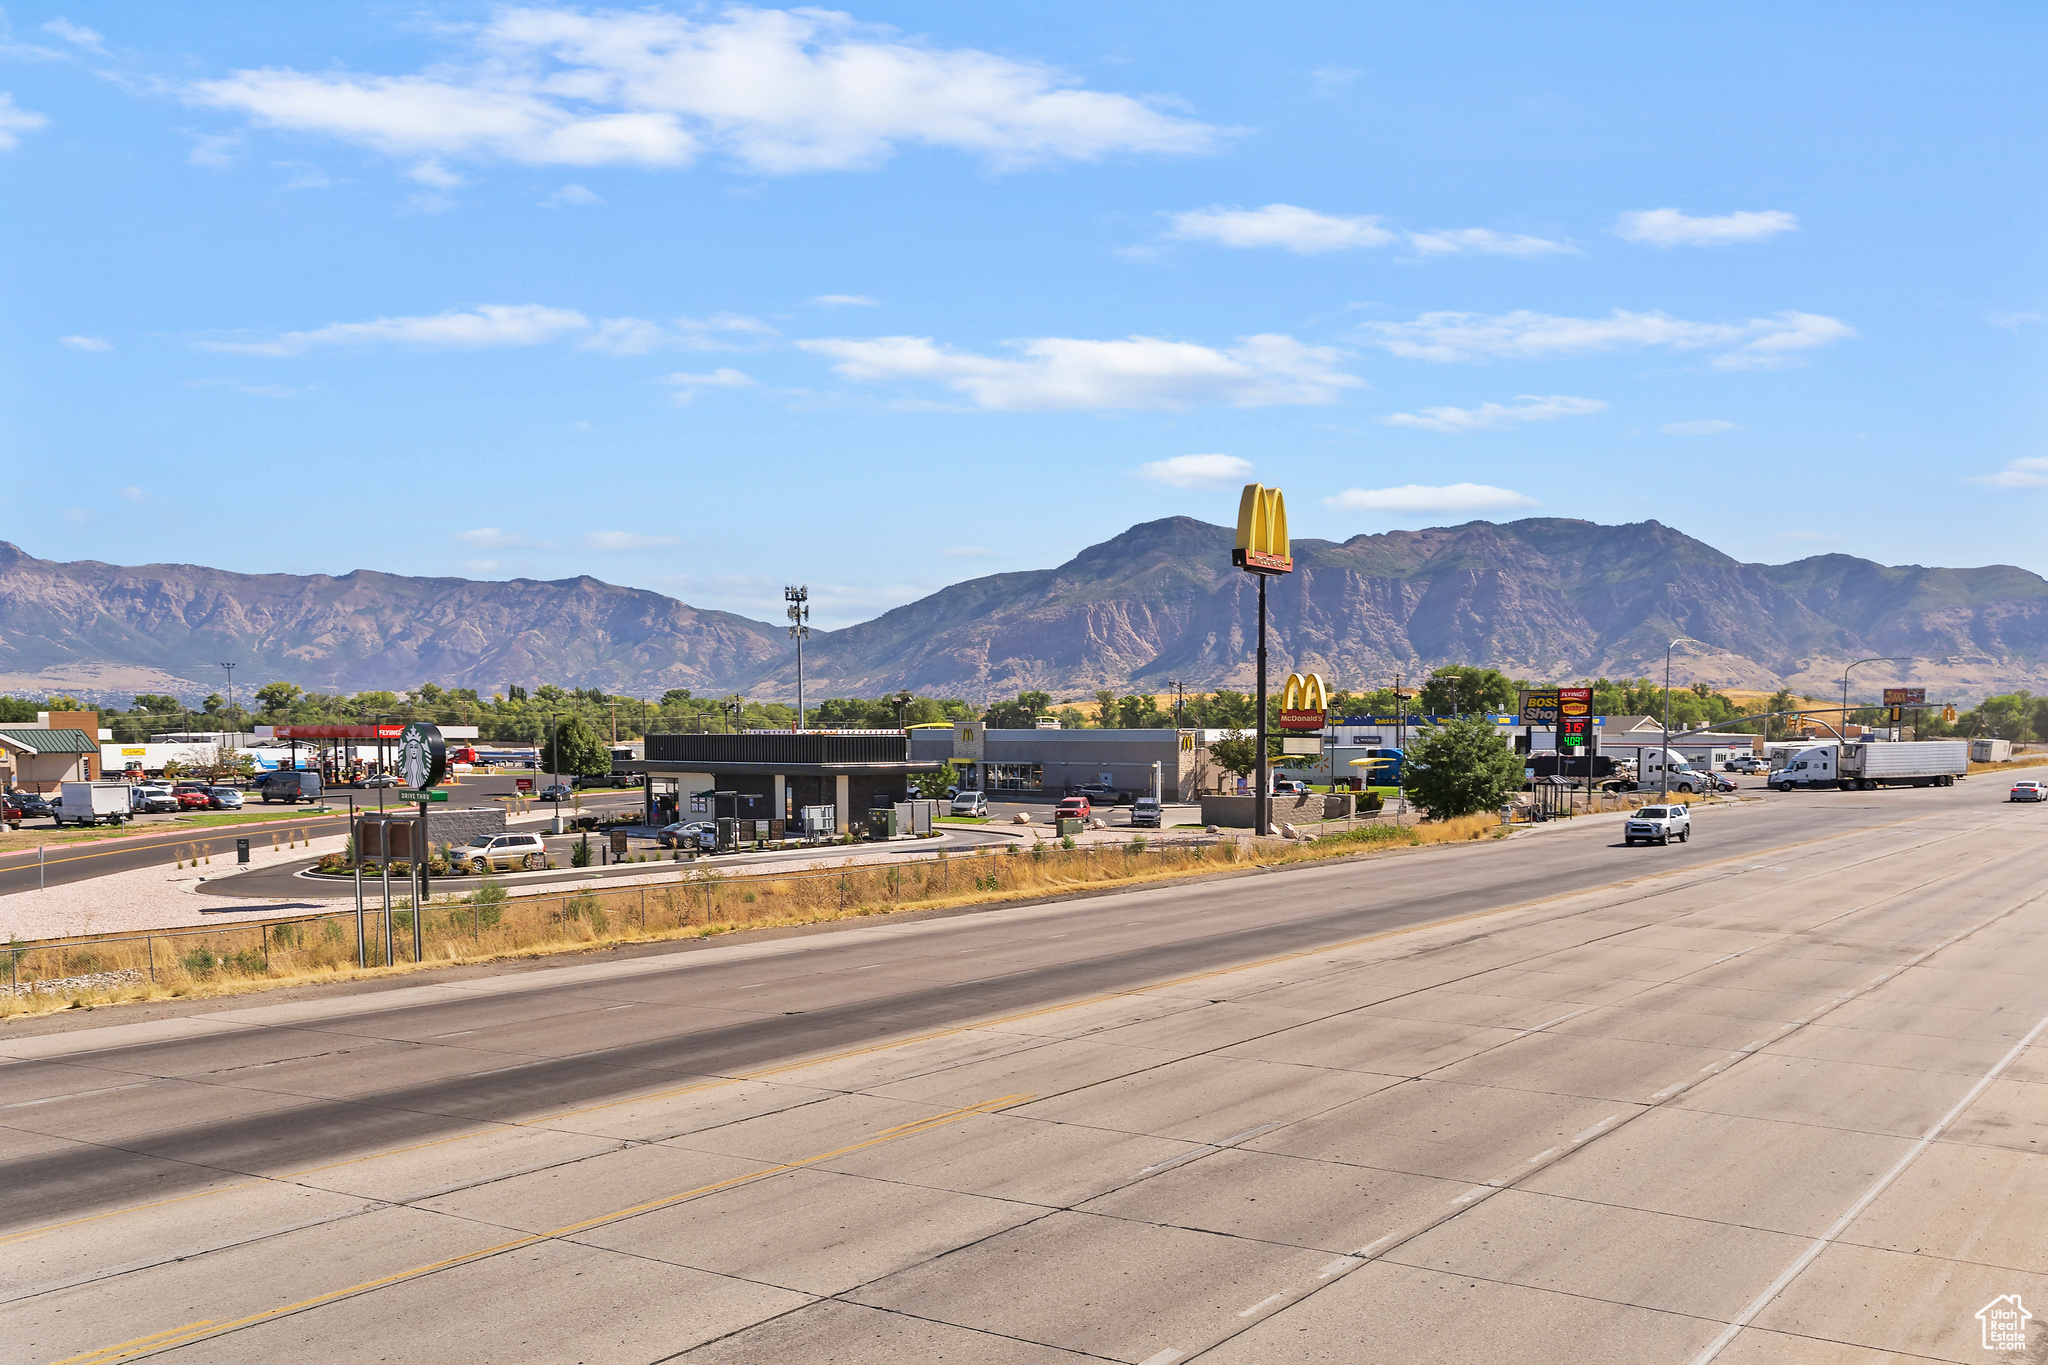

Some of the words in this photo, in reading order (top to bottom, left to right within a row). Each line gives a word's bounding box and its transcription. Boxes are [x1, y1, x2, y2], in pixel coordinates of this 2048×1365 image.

[1528, 697, 1558, 708] BOSS
[1280, 714, 1323, 722] McDonald's
[401, 792, 416, 800] DRIVE
